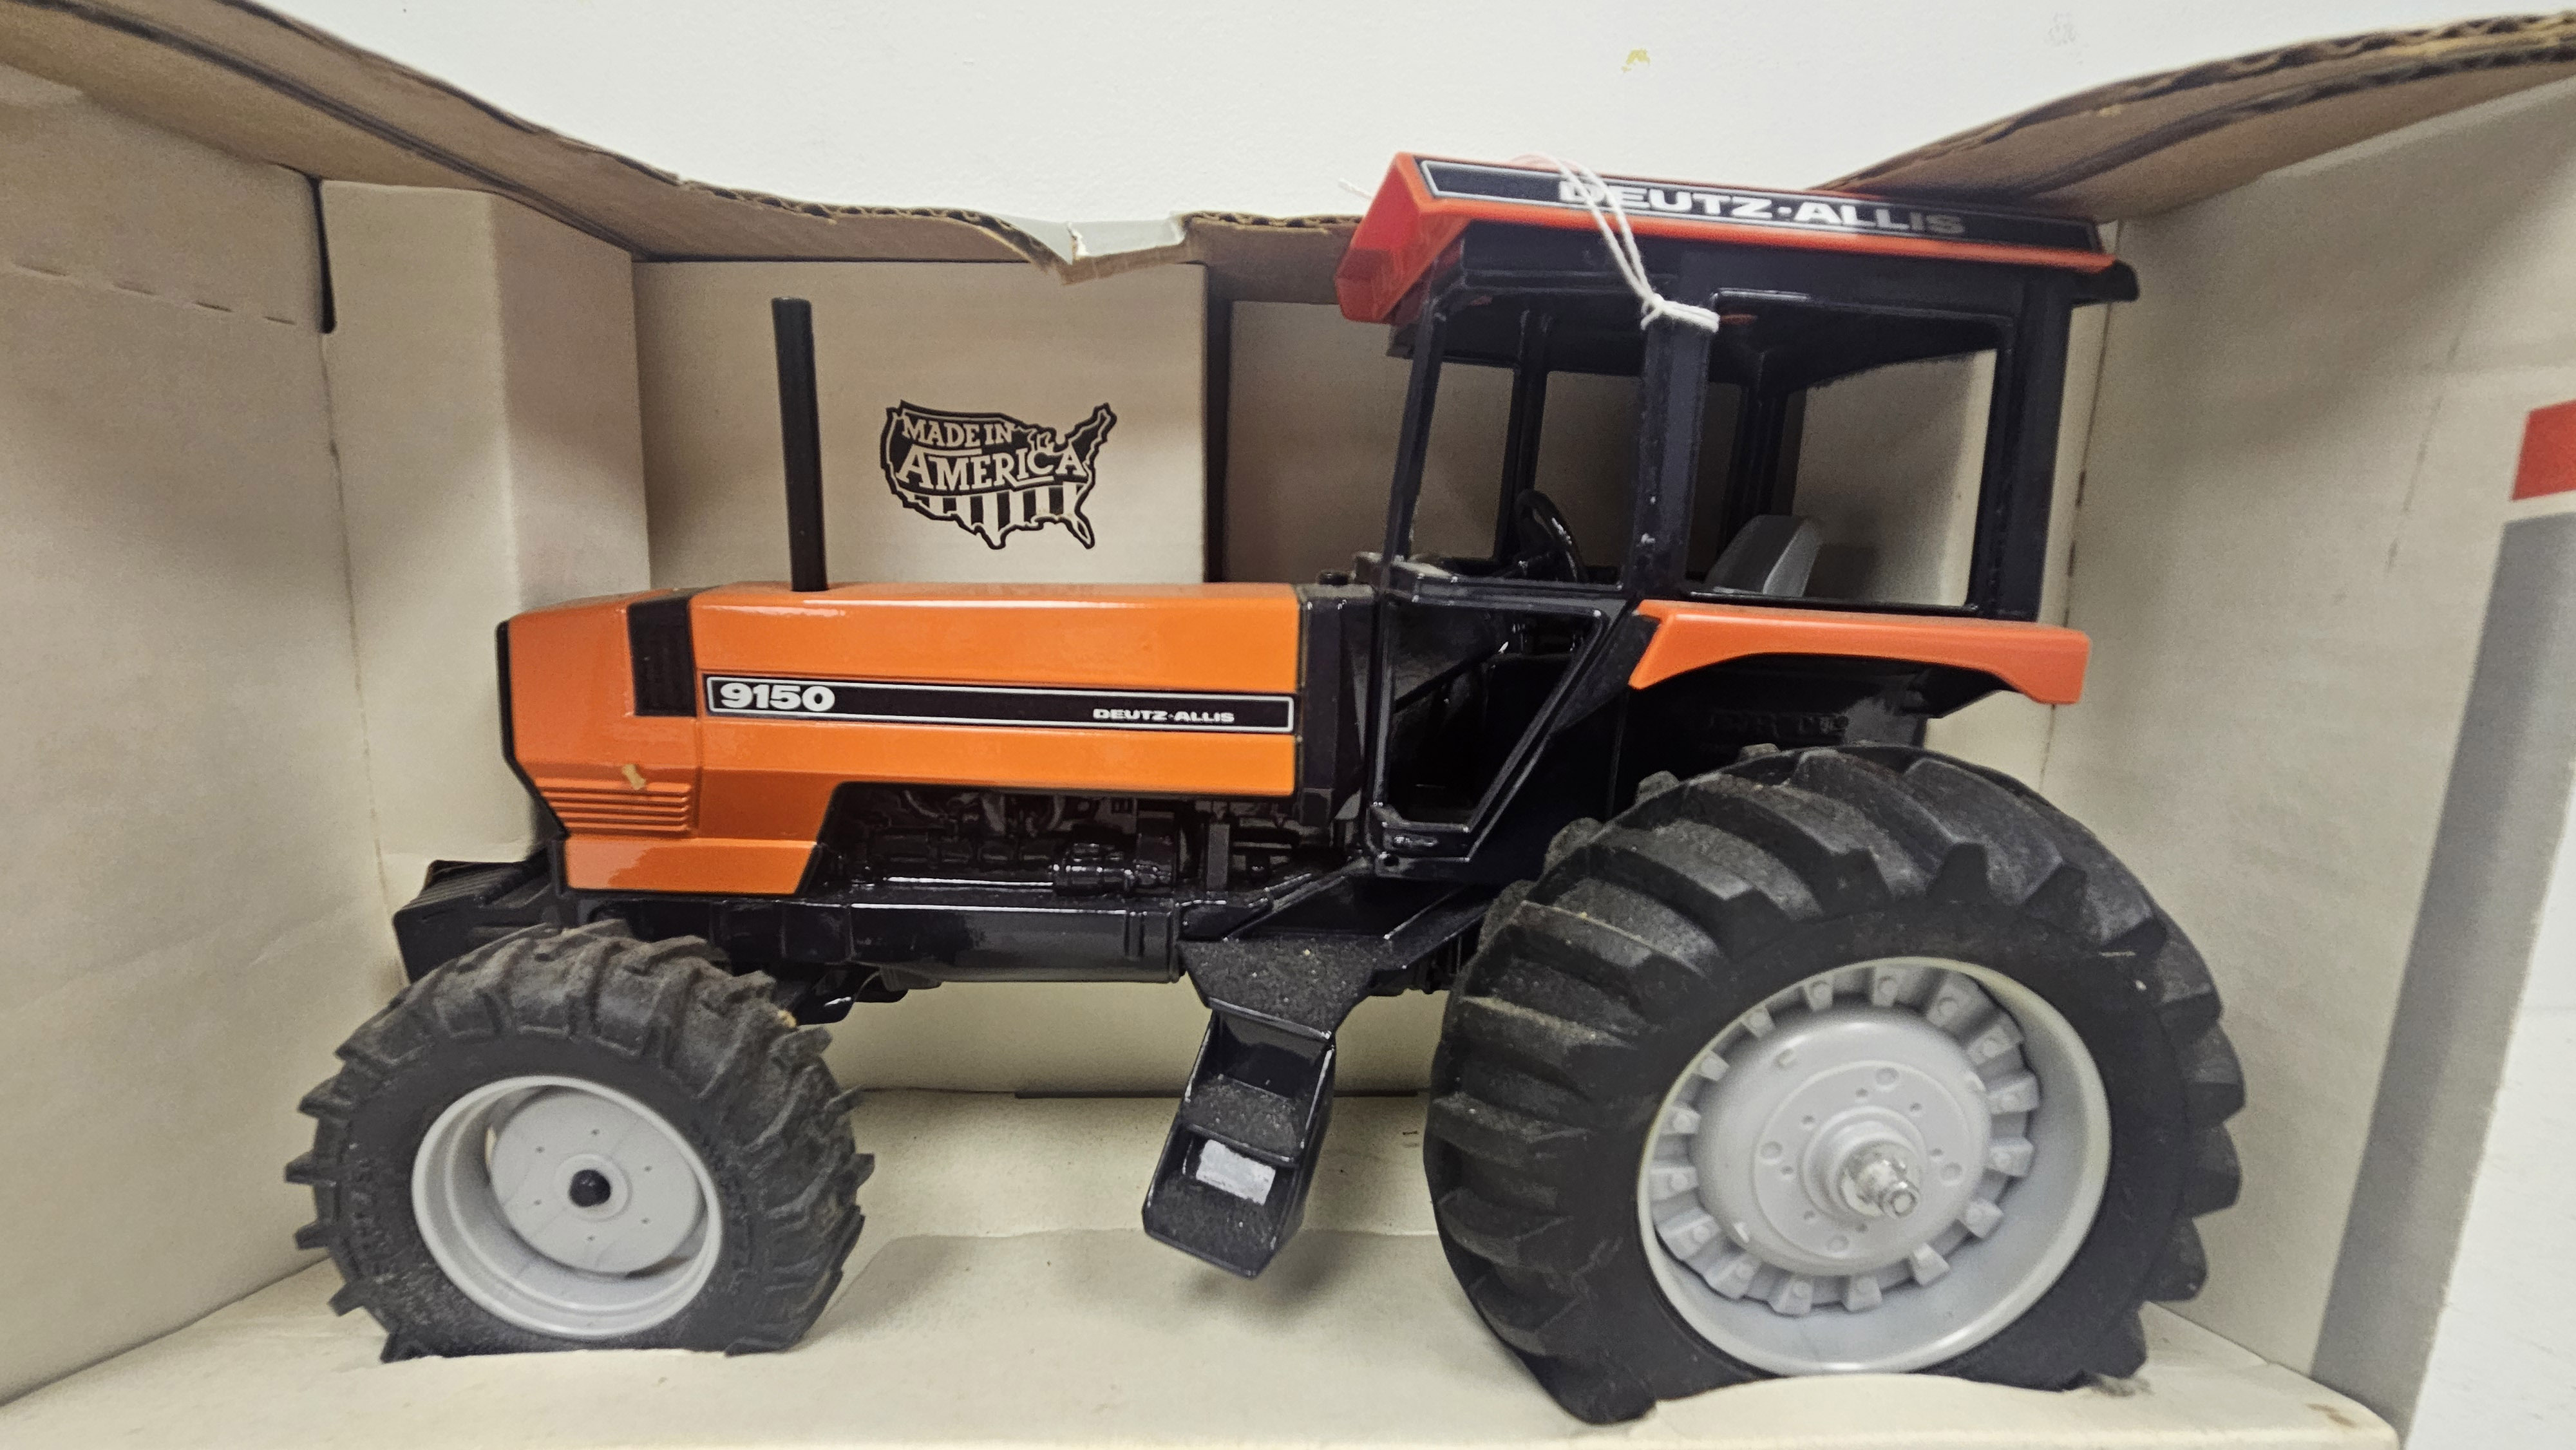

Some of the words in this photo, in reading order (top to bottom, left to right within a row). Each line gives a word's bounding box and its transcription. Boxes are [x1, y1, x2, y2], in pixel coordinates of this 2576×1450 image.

[902, 415, 980, 447] MADE
[984, 422, 1015, 445] IN
[896, 441, 1088, 491] AMERICA
[720, 683, 835, 711] 9150
